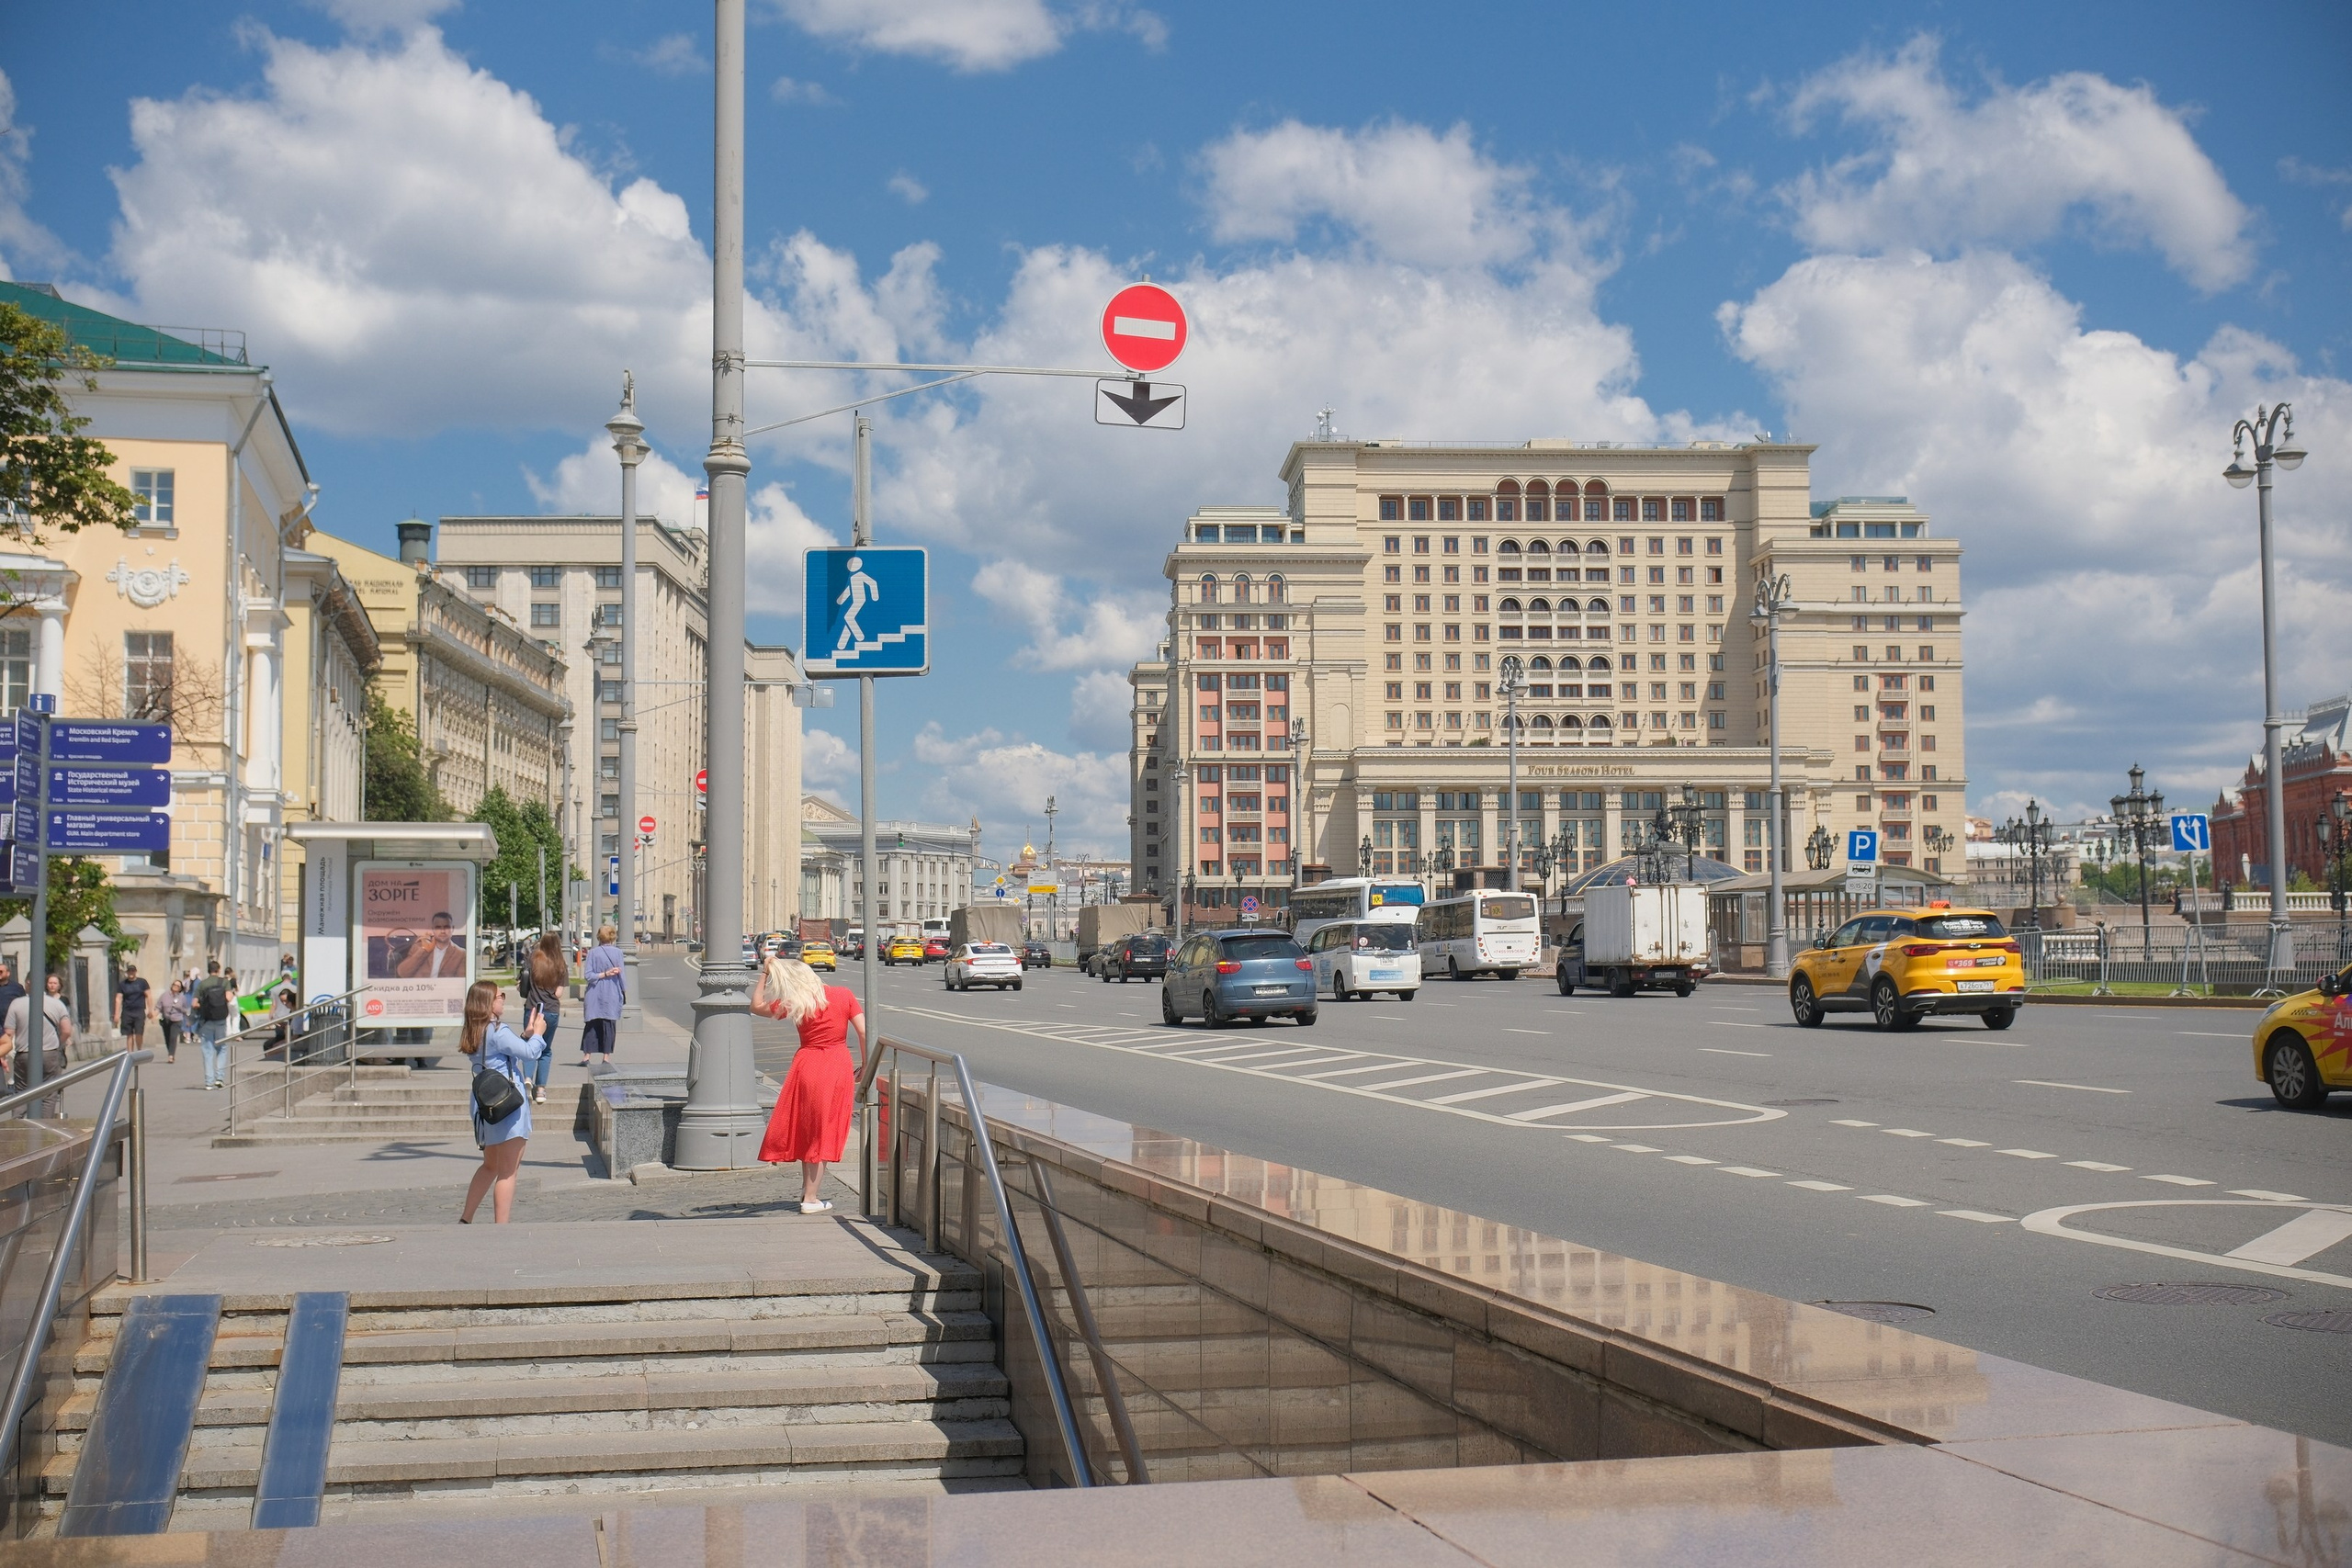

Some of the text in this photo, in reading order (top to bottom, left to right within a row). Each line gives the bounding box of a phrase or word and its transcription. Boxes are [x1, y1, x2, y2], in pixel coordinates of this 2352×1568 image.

[112, 728, 139, 737] Кремль
[1556, 765, 1599, 775] SEASONS
[1600, 765, 1635, 775] HOTEL
[67, 771, 128, 779] Государственный
[67, 778, 140, 787] Исторический музей
[96, 815, 151, 823] универсальный
[1855, 835, 1871, 857] P
[317, 856, 327, 935] Манежная площадь
[368, 888, 420, 901] ЗОРГЕ
